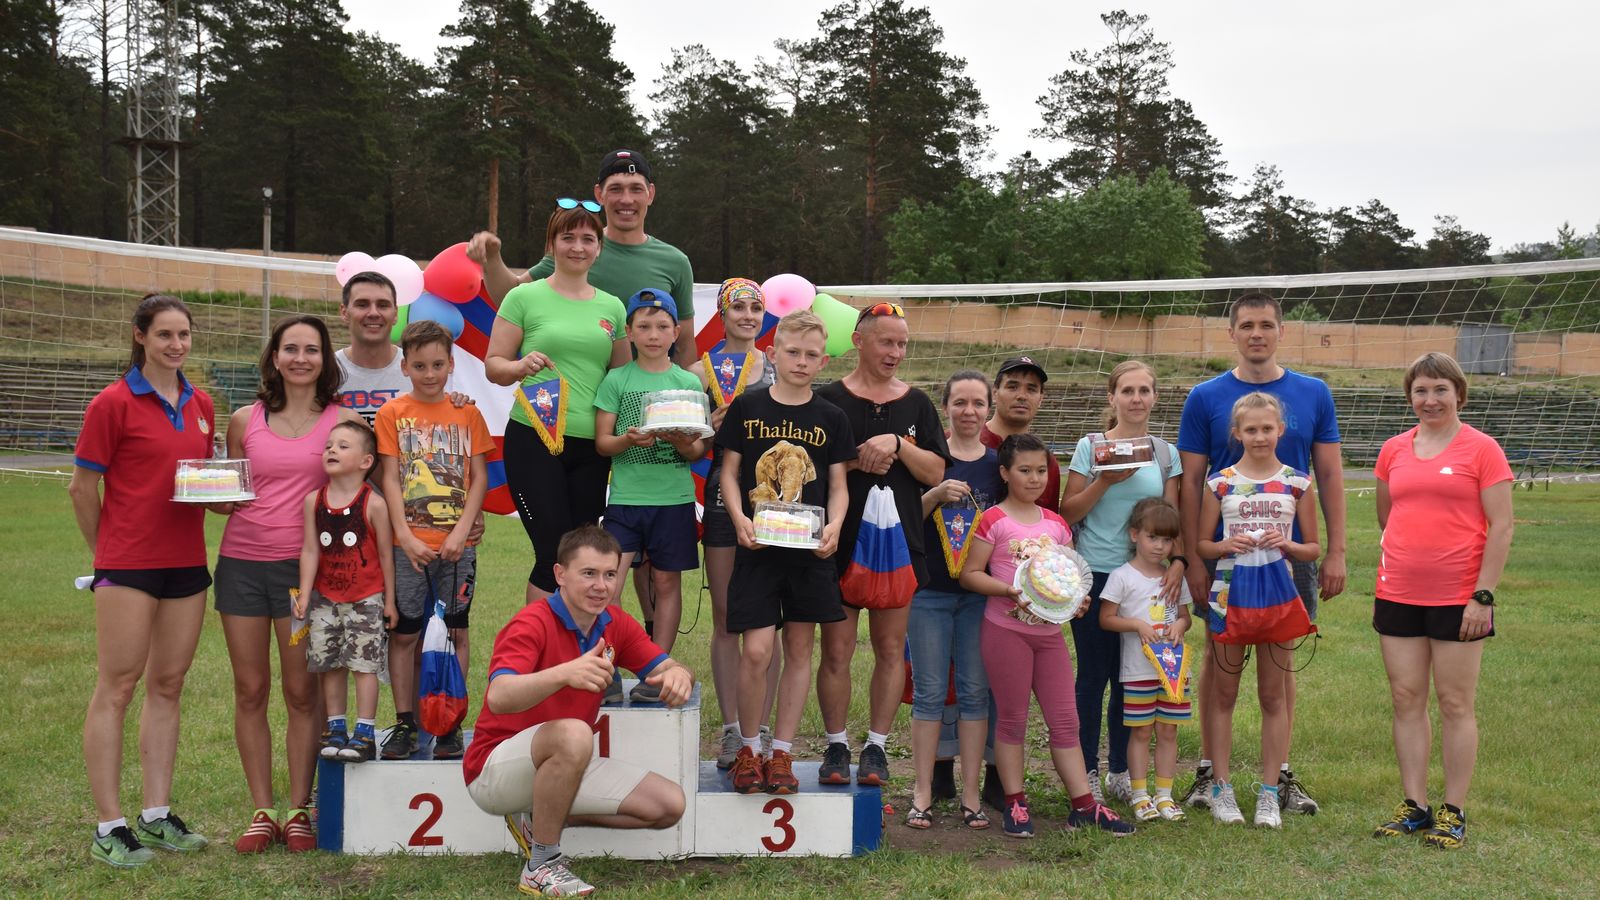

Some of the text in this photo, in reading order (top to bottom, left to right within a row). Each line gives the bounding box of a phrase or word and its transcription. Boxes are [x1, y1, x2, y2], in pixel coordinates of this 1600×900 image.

[1320, 334, 1331, 348] 15
[1238, 500, 1282, 519] CHIC
[591, 713, 610, 758] 1
[408, 792, 444, 847] 2
[760, 798, 797, 853] 3
